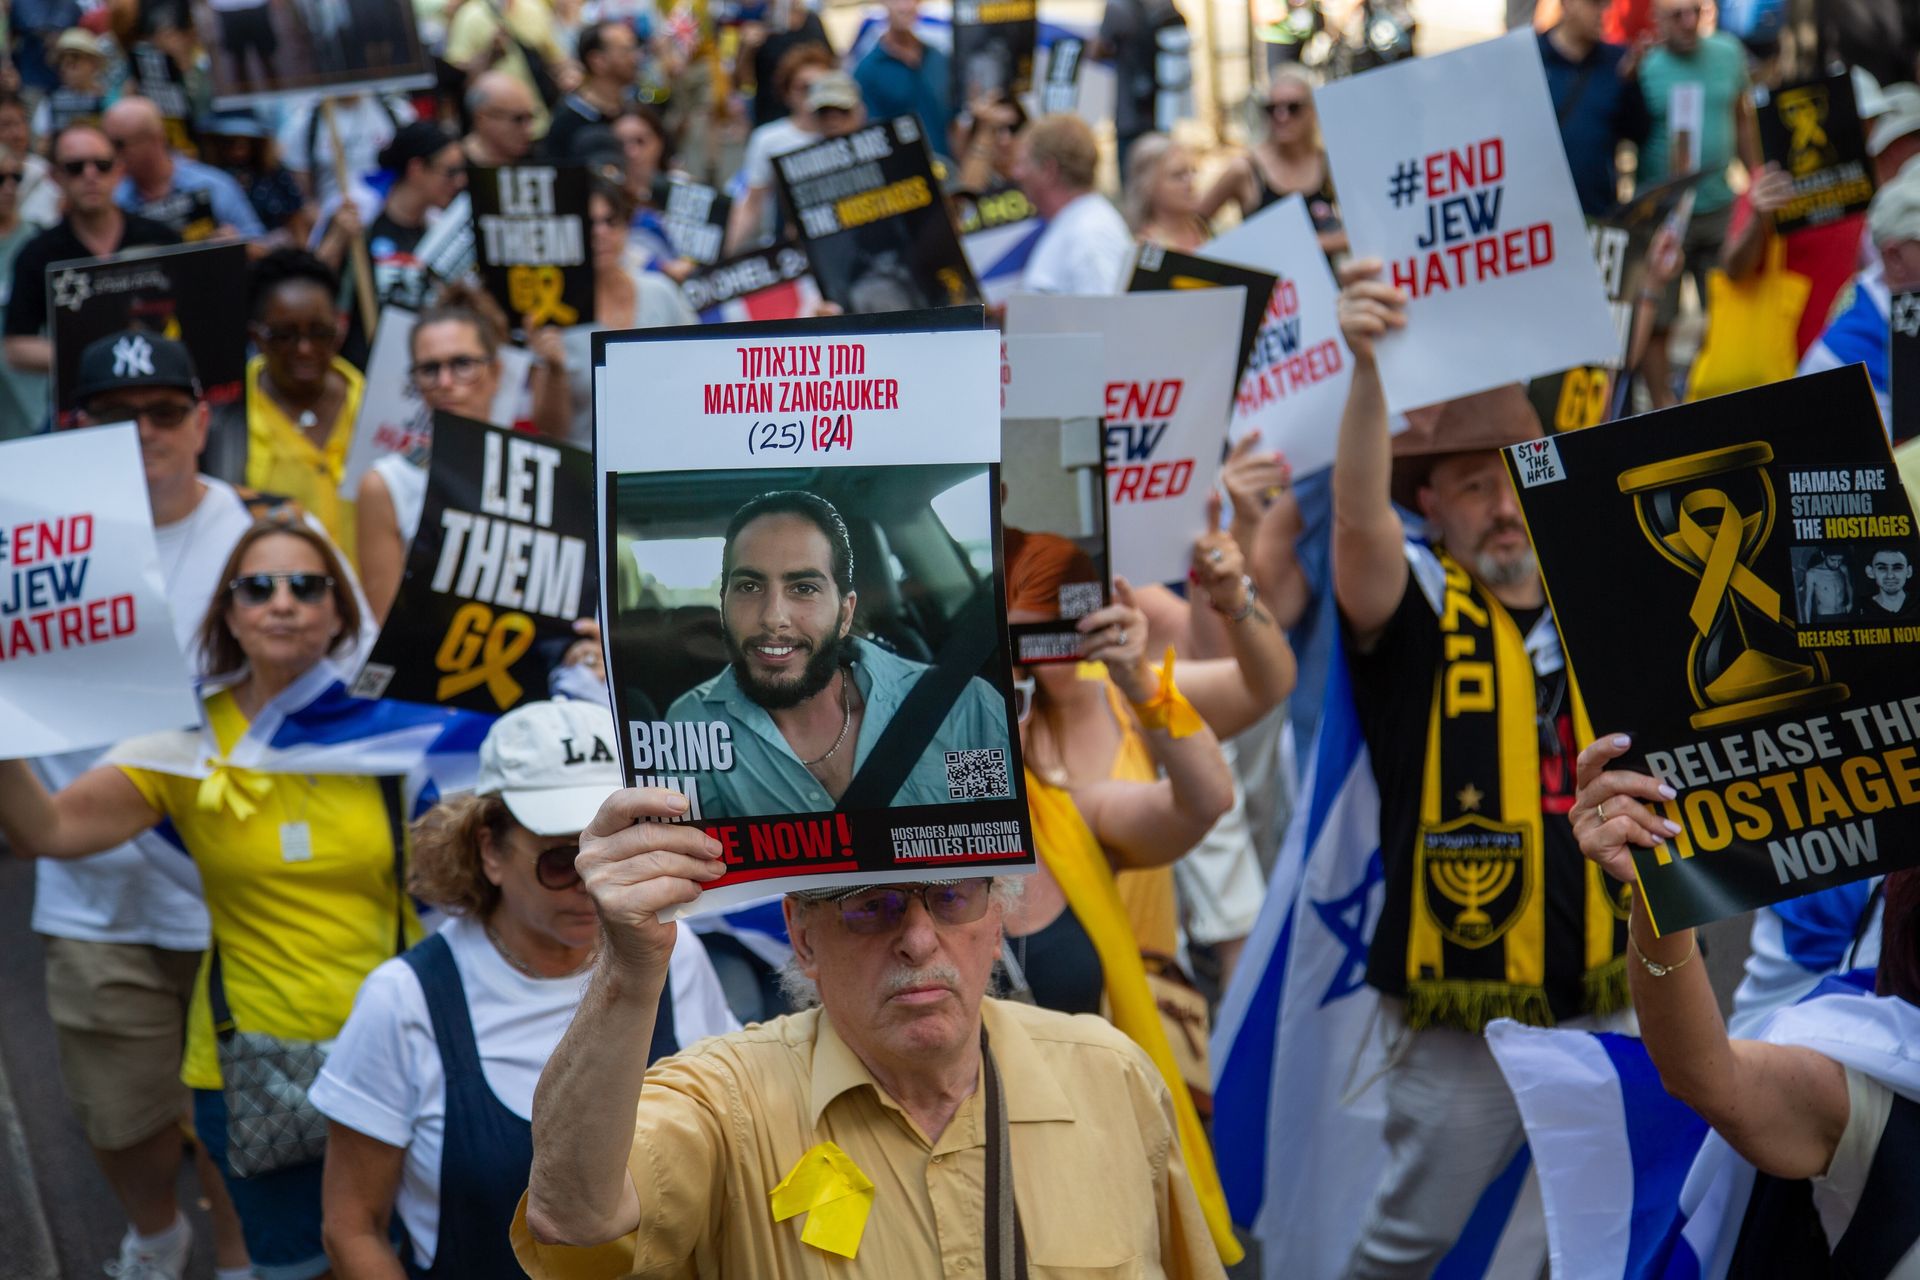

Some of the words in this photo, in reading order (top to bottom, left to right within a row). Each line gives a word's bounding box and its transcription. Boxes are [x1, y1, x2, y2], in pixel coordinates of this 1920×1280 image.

[497, 166, 557, 216] LET
[1388, 137, 1505, 208] #END
[1416, 185, 1504, 249] JEW
[479, 214, 585, 267] THEM
[1392, 221, 1556, 300] HATRED
[1263, 278, 1299, 325] ND
[112, 334, 155, 378] NY
[737, 345, 821, 381] צנגאוקר
[828, 344, 865, 379] מתן
[1236, 337, 1344, 417] HATRED
[704, 382, 773, 415] MATAN
[778, 379, 899, 413] ZANGAUKER
[748, 420, 805, 455] (25)
[811, 414, 853, 452] (24)
[1105, 423, 1168, 462] EW
[480, 430, 561, 528] LET
[1526, 454, 1550, 470] THE
[1527, 466, 1556, 483] HATE
[1789, 470, 1850, 494] HAMAS
[1855, 469, 1886, 491] ARE
[1791, 494, 1873, 517] STARVING
[1793, 518, 1823, 540] THE
[1825, 515, 1911, 540] HOSTAGES
[0, 513, 94, 567] END
[2, 556, 90, 615] JEW
[431, 508, 587, 620] THEM
[0, 592, 136, 662] ATRED
[1797, 629, 1852, 649] RELEASE
[1852, 627, 1891, 646] THEM
[561, 734, 614, 766] LA
[629, 720, 733, 771] BRING
[1644, 716, 1842, 791] RELEASE
[1841, 696, 1920, 751] THE
[749, 813, 854, 863] NOW!
[890, 825, 946, 841] HOSTAGES
[948, 823, 970, 838] AND
[972, 820, 1020, 836] MISSING
[893, 837, 963, 859] FAMILIES
[966, 834, 1023, 855] FORUM
[1767, 818, 1879, 885] NOW
